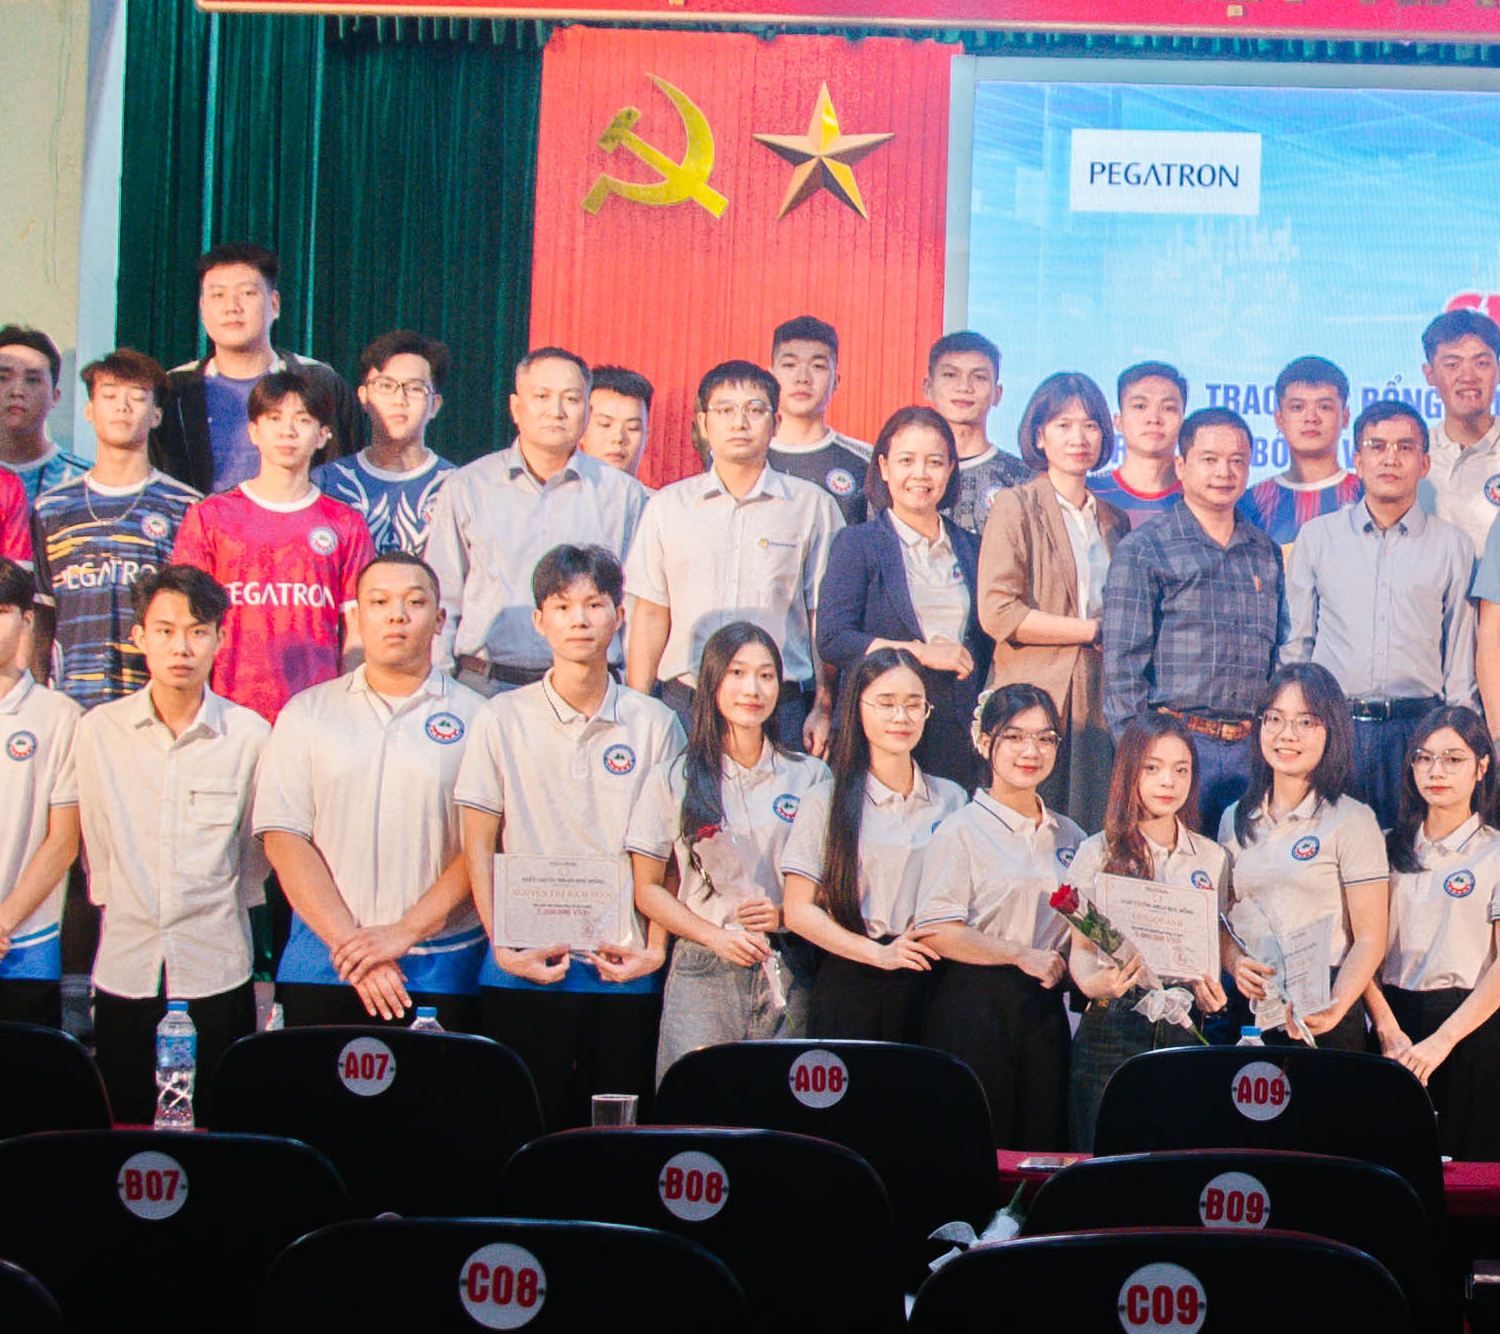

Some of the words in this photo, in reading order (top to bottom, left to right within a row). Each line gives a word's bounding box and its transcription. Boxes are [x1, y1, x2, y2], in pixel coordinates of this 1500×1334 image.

[1090, 160, 1240, 188] PEGATRON
[61, 557, 158, 590] EGATR
[223, 581, 335, 610] EGATRON
[344, 1051, 389, 1080] A07
[1237, 1076, 1285, 1105] A09
[665, 1167, 723, 1204] B08
[1206, 1188, 1264, 1224] B09
[467, 1263, 538, 1308] C08
[1127, 1285, 1198, 1325] C09
